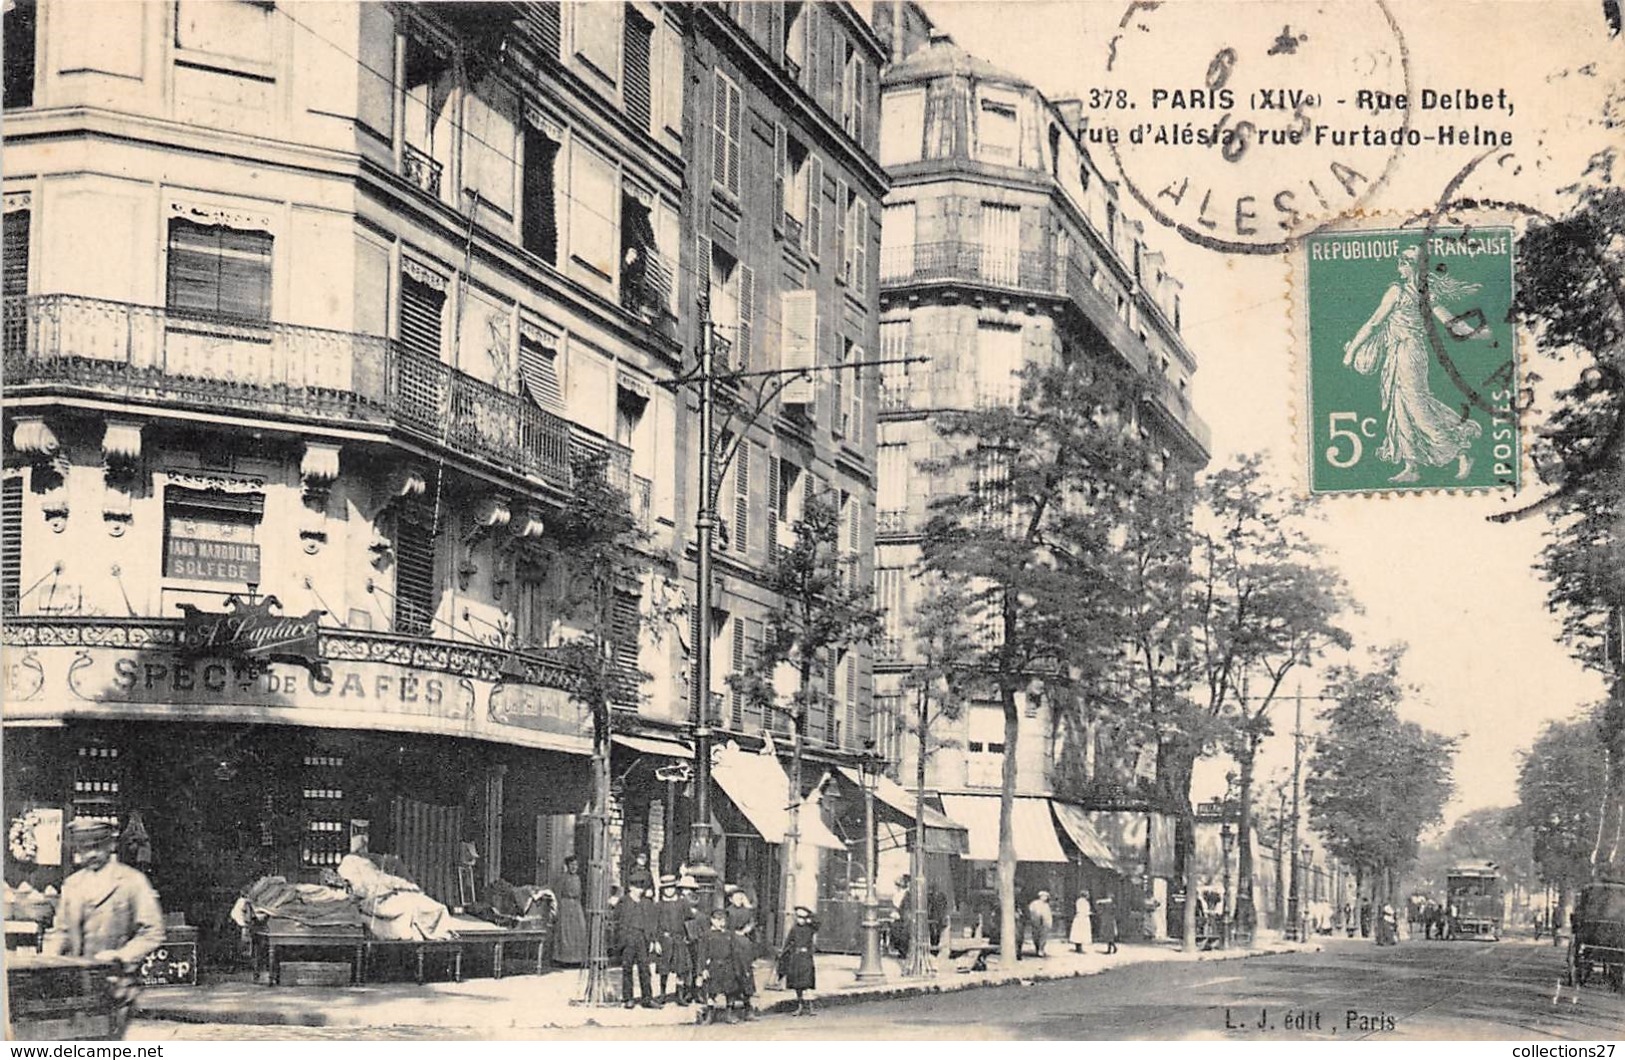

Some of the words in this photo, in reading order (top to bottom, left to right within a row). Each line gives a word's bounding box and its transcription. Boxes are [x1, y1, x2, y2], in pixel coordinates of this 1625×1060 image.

[1157, 161, 1368, 236] ALESIA
[1493, 389, 1512, 475] POSTES
[169, 540, 196, 556] IANO
[267, 674, 297, 694] DE
